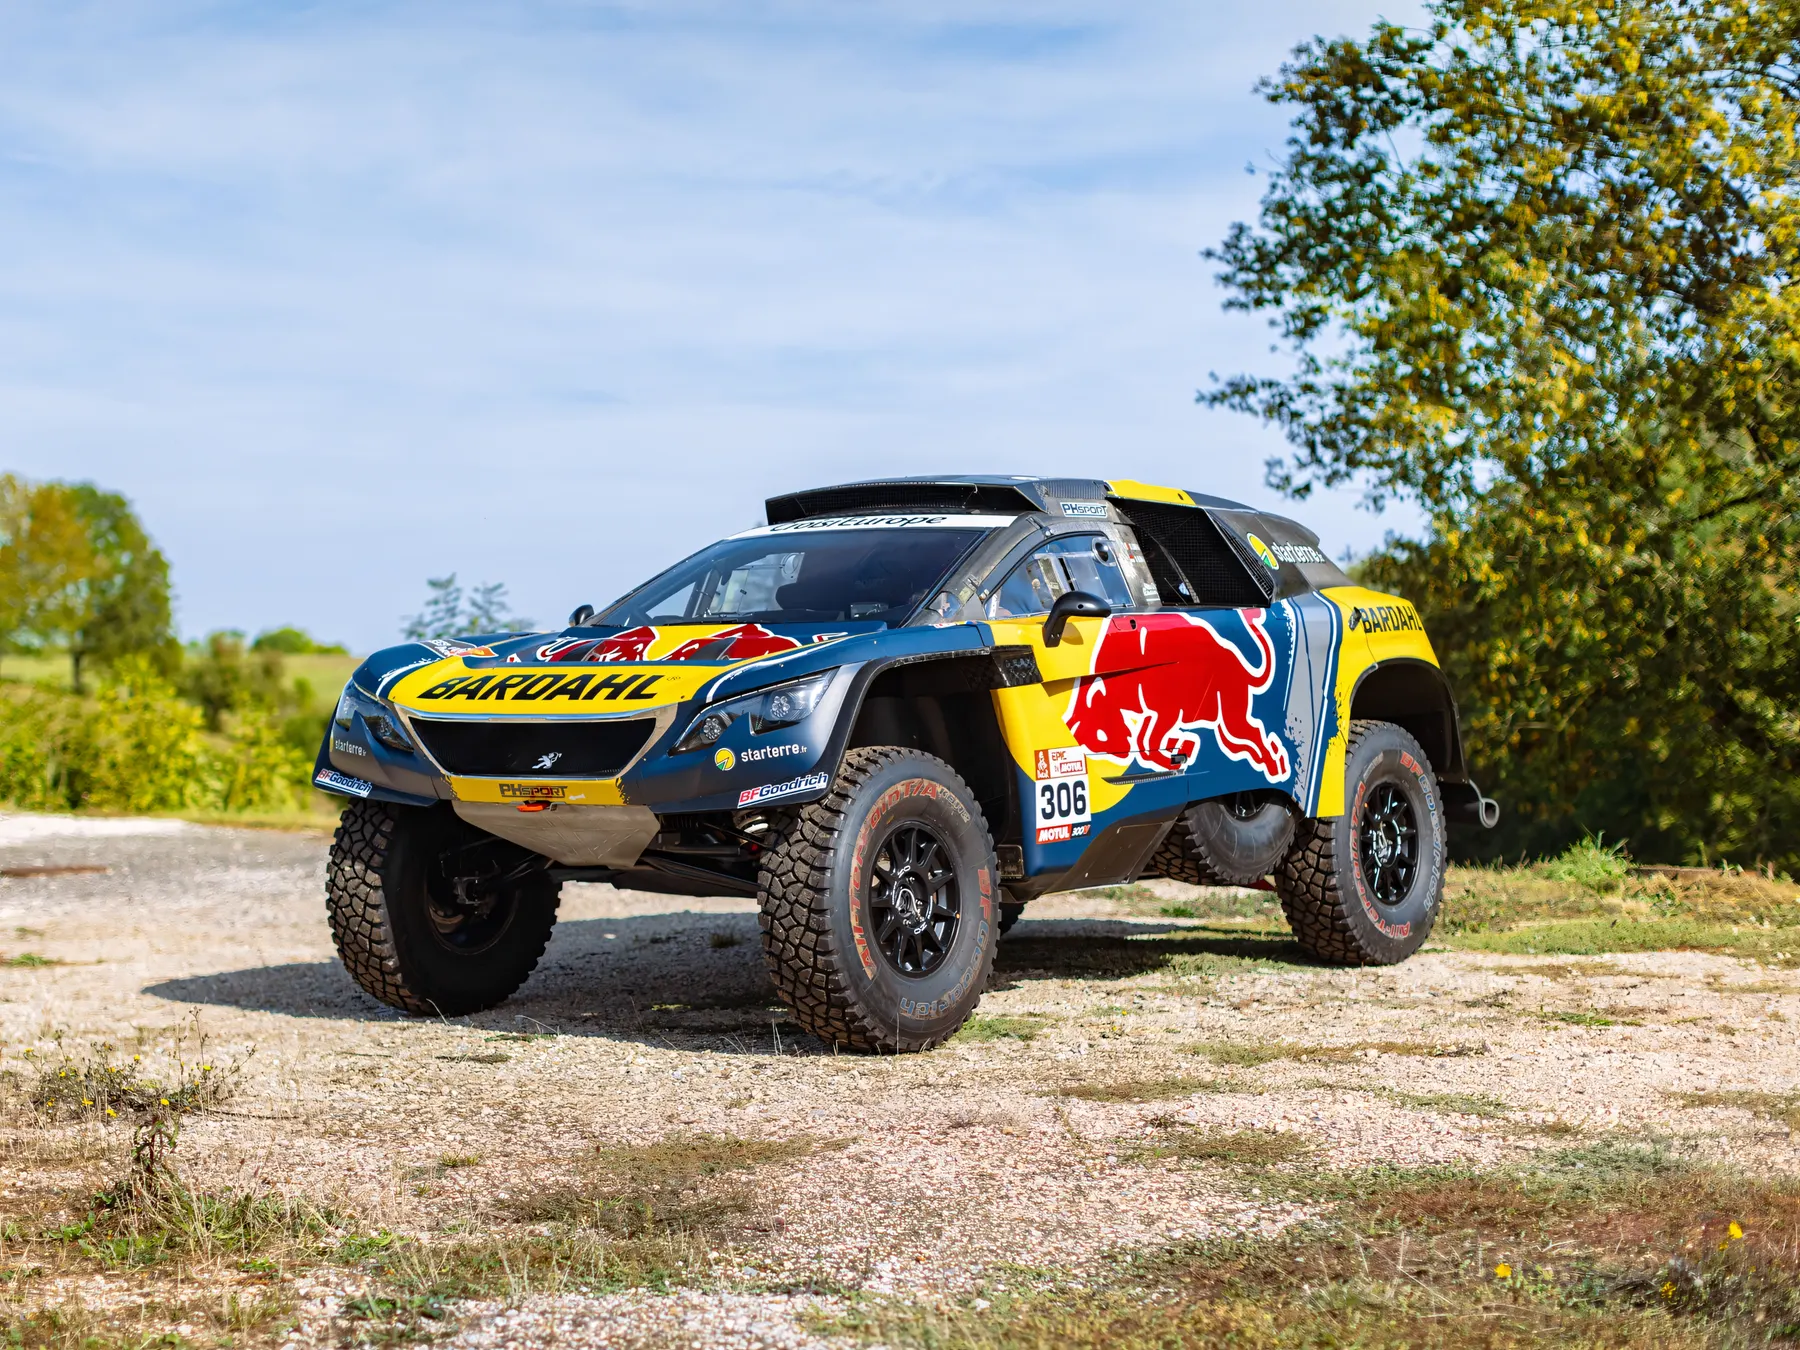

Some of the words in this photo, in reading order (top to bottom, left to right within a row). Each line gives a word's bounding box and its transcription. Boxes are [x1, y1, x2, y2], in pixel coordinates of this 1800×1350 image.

[1358, 606, 1423, 634] BARDAHL
[416, 673, 666, 701] BARDAHL
[740, 743, 808, 763] starterre.fr
[317, 768, 373, 794] BFGoodrich
[738, 771, 829, 803] BFGoodrich
[1040, 779, 1087, 820] 306
[1038, 825, 1070, 843] MOTUL
